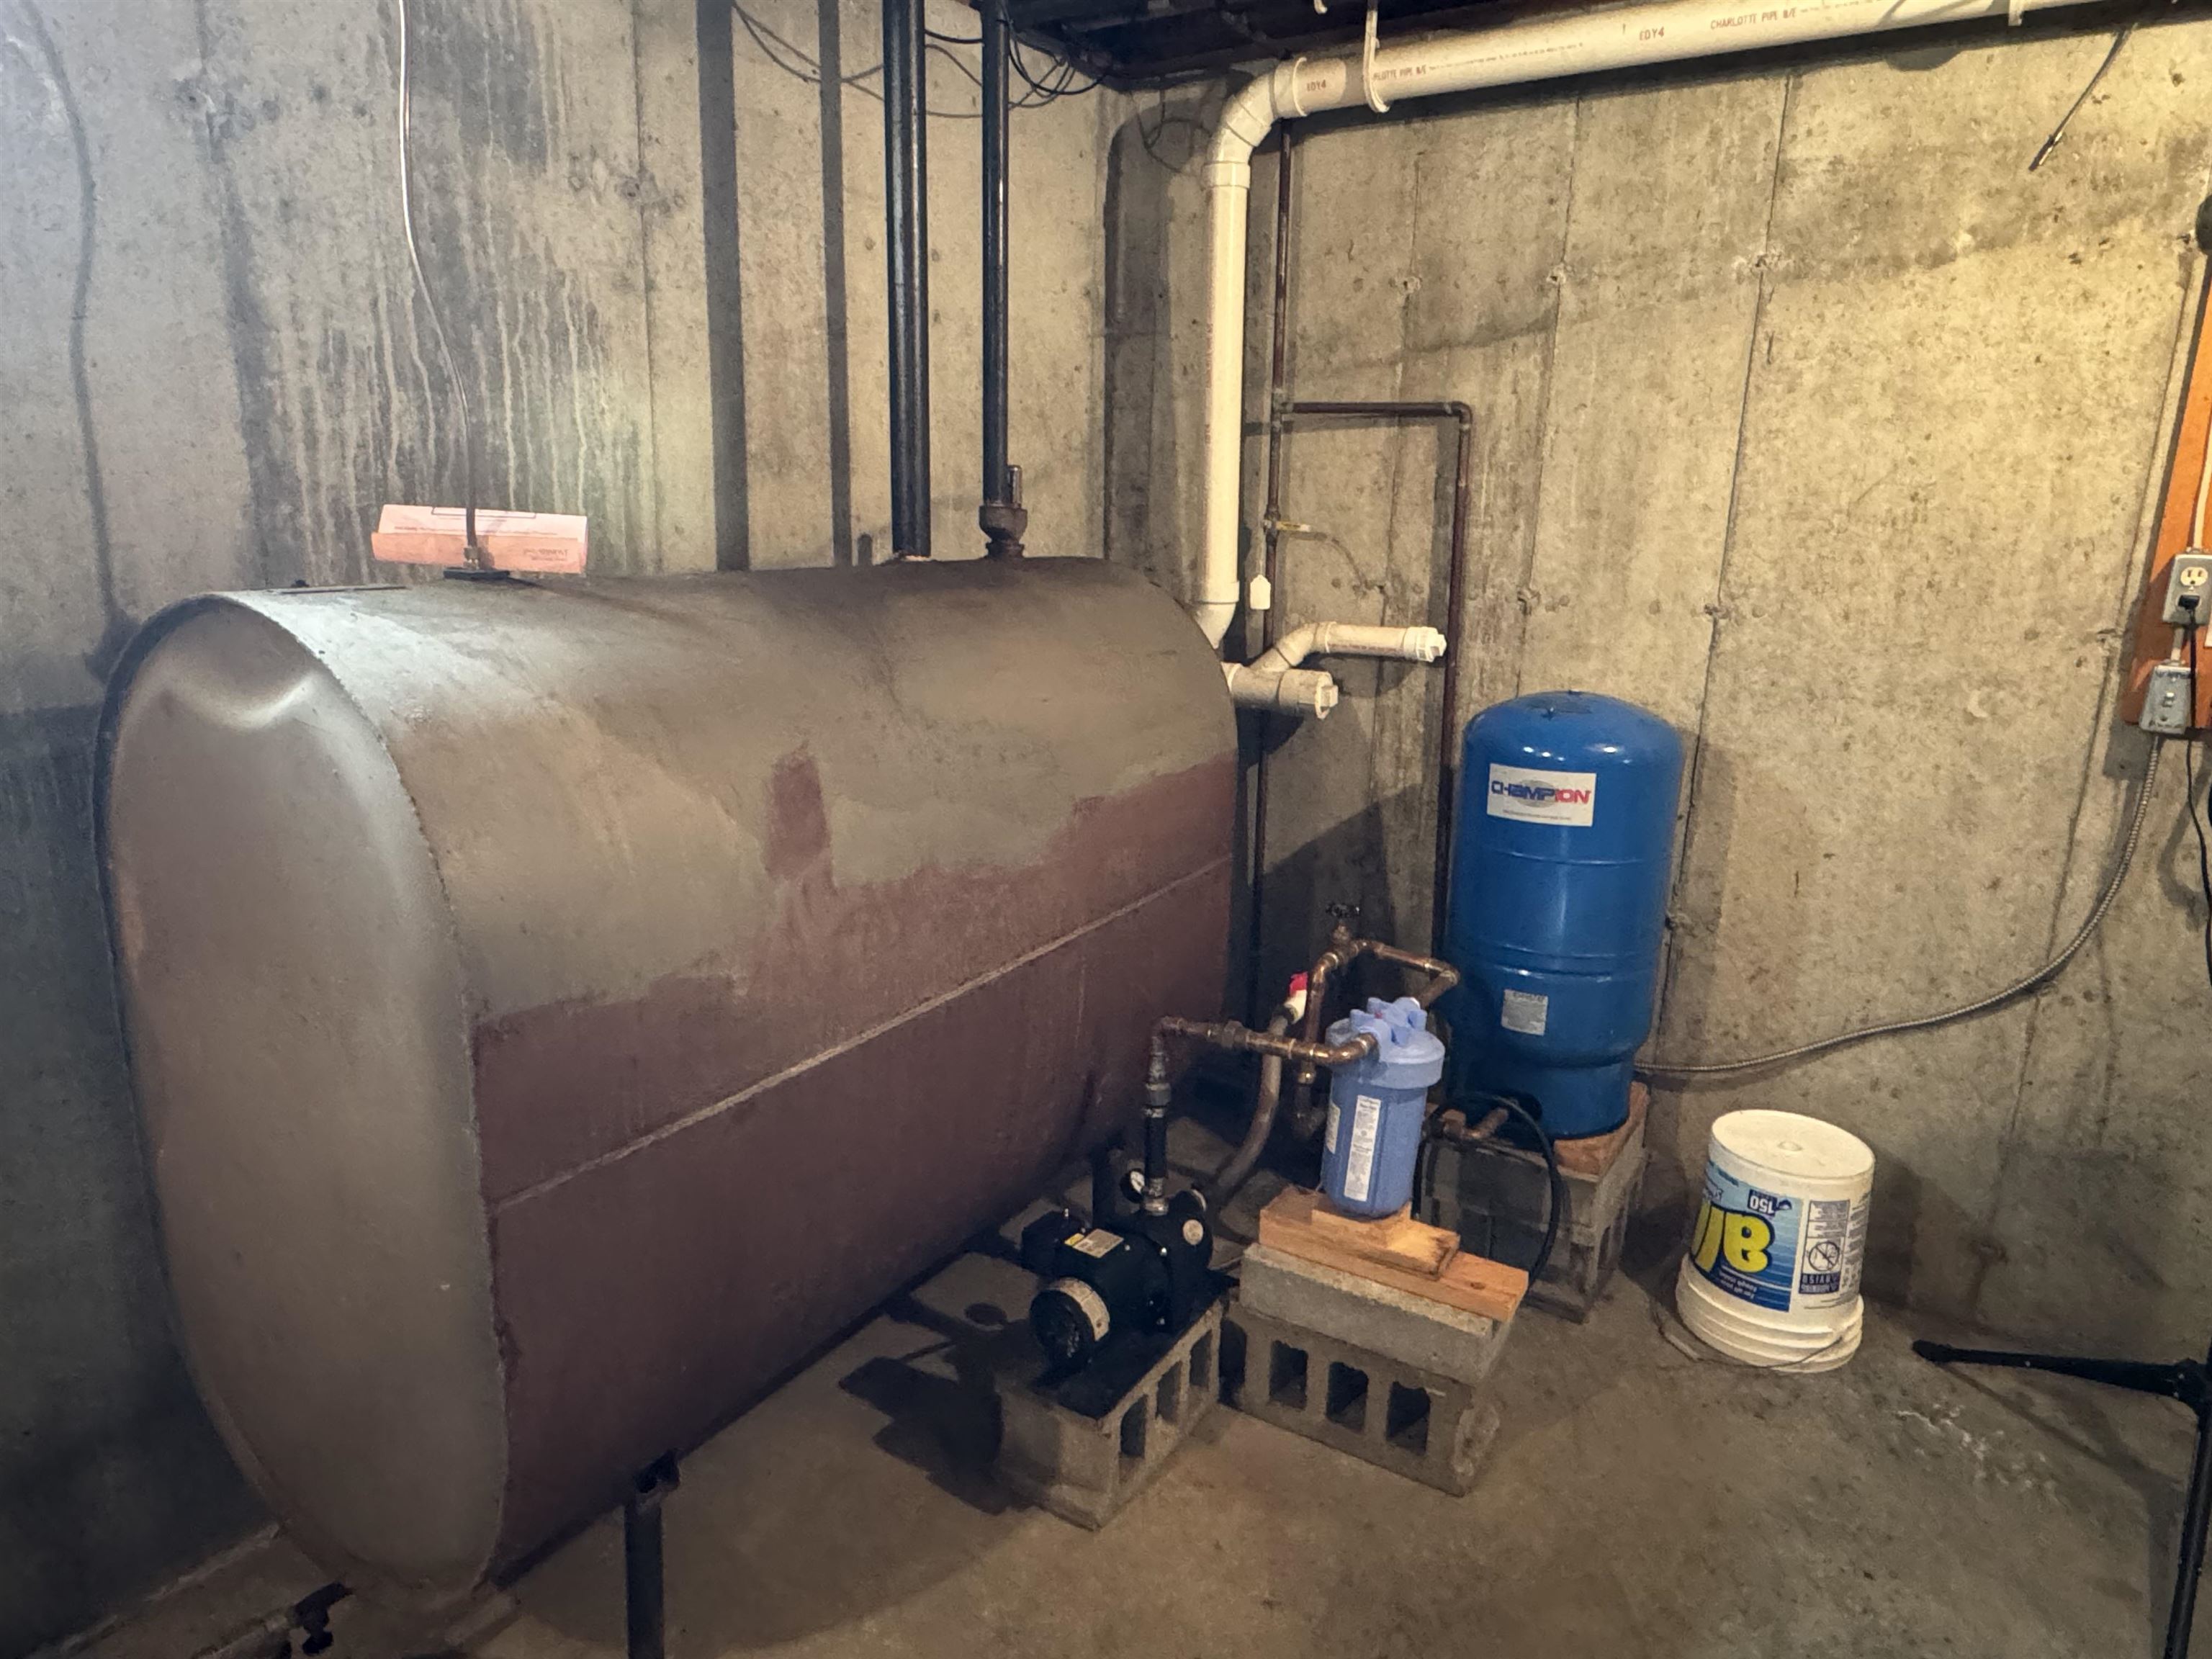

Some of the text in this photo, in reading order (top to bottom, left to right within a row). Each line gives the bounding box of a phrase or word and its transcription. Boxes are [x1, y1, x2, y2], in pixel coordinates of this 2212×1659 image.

[1711, 13, 1757, 30] CHARLOTTE
[1491, 780, 1591, 804] CHAMPION
[1750, 1195, 1776, 1214] 150
